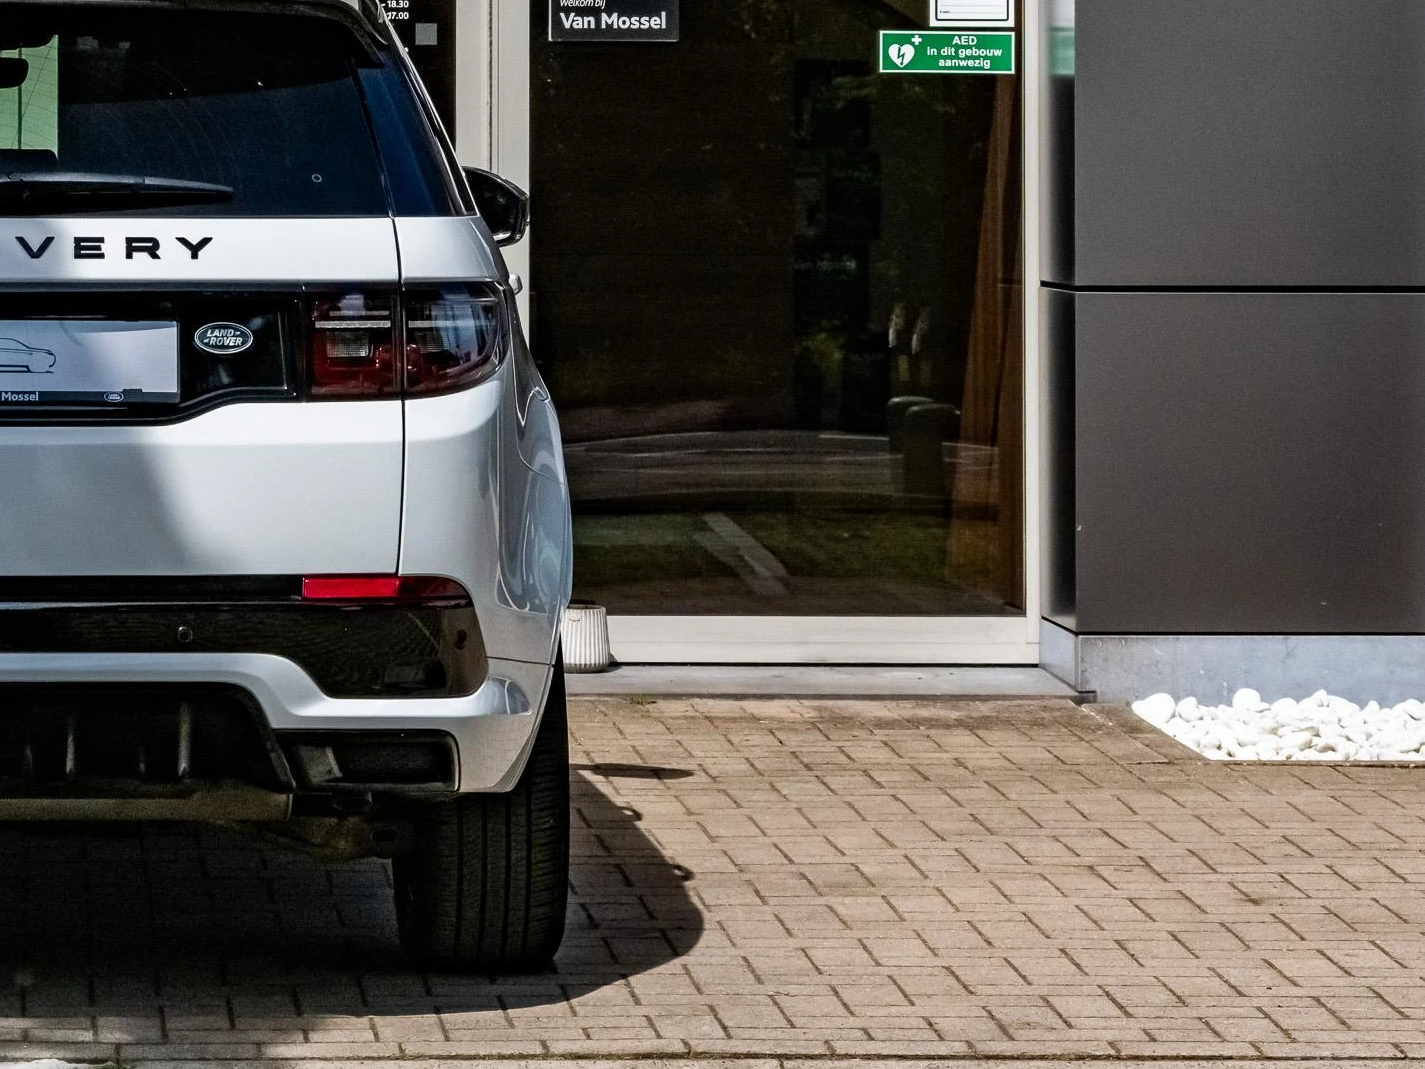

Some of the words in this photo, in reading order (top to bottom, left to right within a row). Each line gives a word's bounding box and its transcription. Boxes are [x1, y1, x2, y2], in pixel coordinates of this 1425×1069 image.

[387, 0, 409, 8] 18.30
[559, 12, 595, 29] Van
[601, 11, 667, 29] Mossel
[952, 35, 977, 45] AED
[927, 46, 937, 56] in
[940, 46, 956, 56] dit
[958, 46, 1003, 58] gebouw
[938, 58, 991, 69] aanwezig
[206, 329, 234, 337] LAND
[209, 337, 243, 346] ROVER
[2, 391, 39, 401] Mossel
